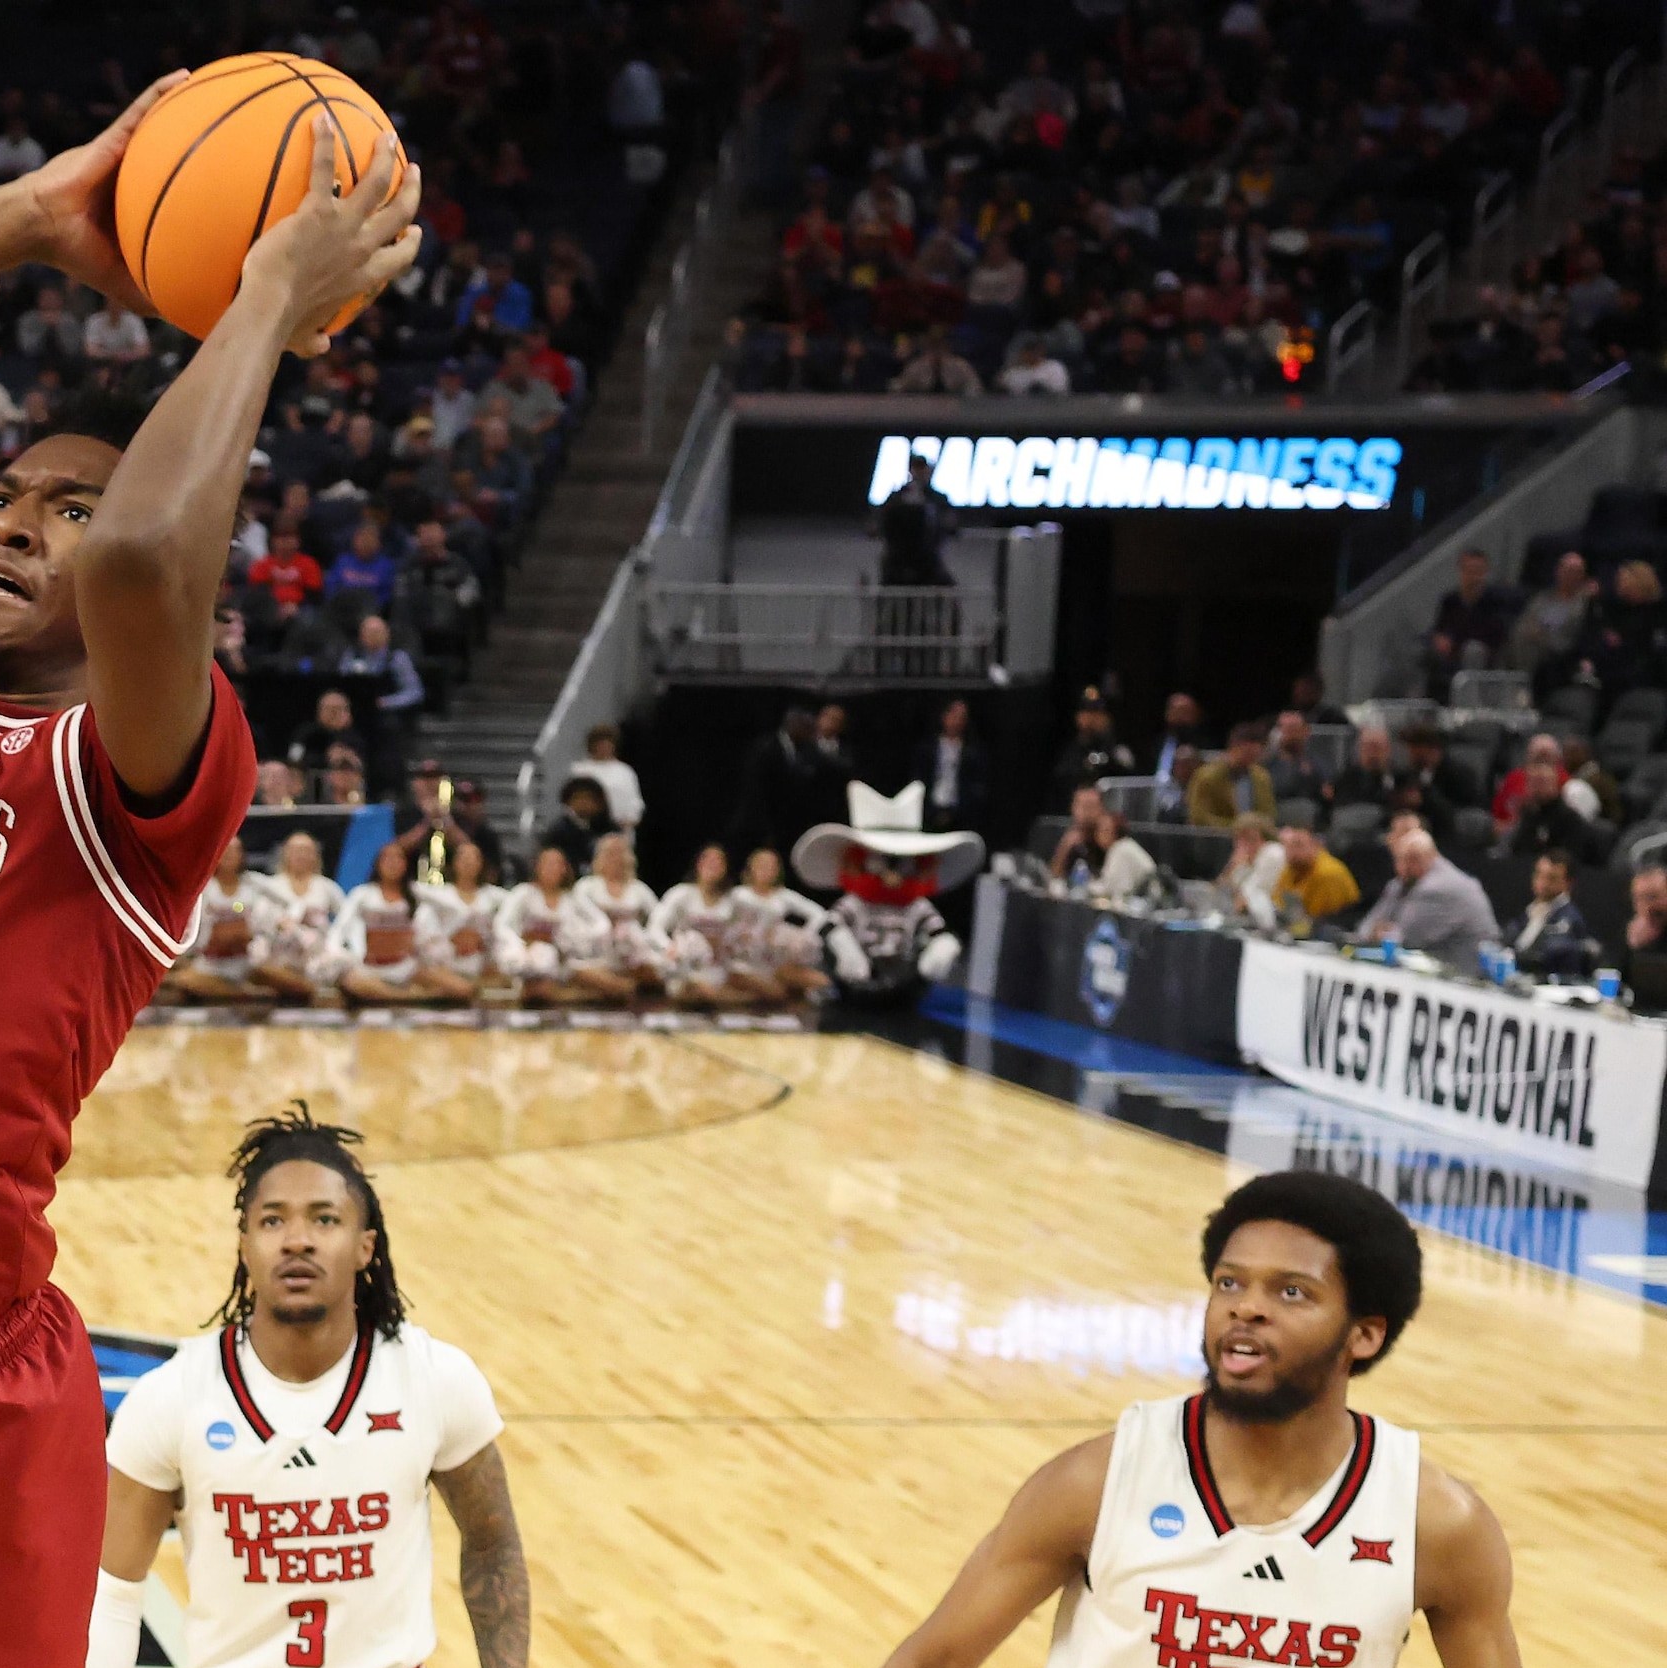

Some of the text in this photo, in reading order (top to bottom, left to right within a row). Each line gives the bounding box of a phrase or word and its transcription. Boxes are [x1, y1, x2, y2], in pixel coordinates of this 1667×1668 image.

[1303, 971, 1596, 1148] WEST REGIONAL
[213, 1492, 391, 1540] TEXAS
[233, 1537, 376, 1584] TECH
[286, 1599, 328, 1668] 3
